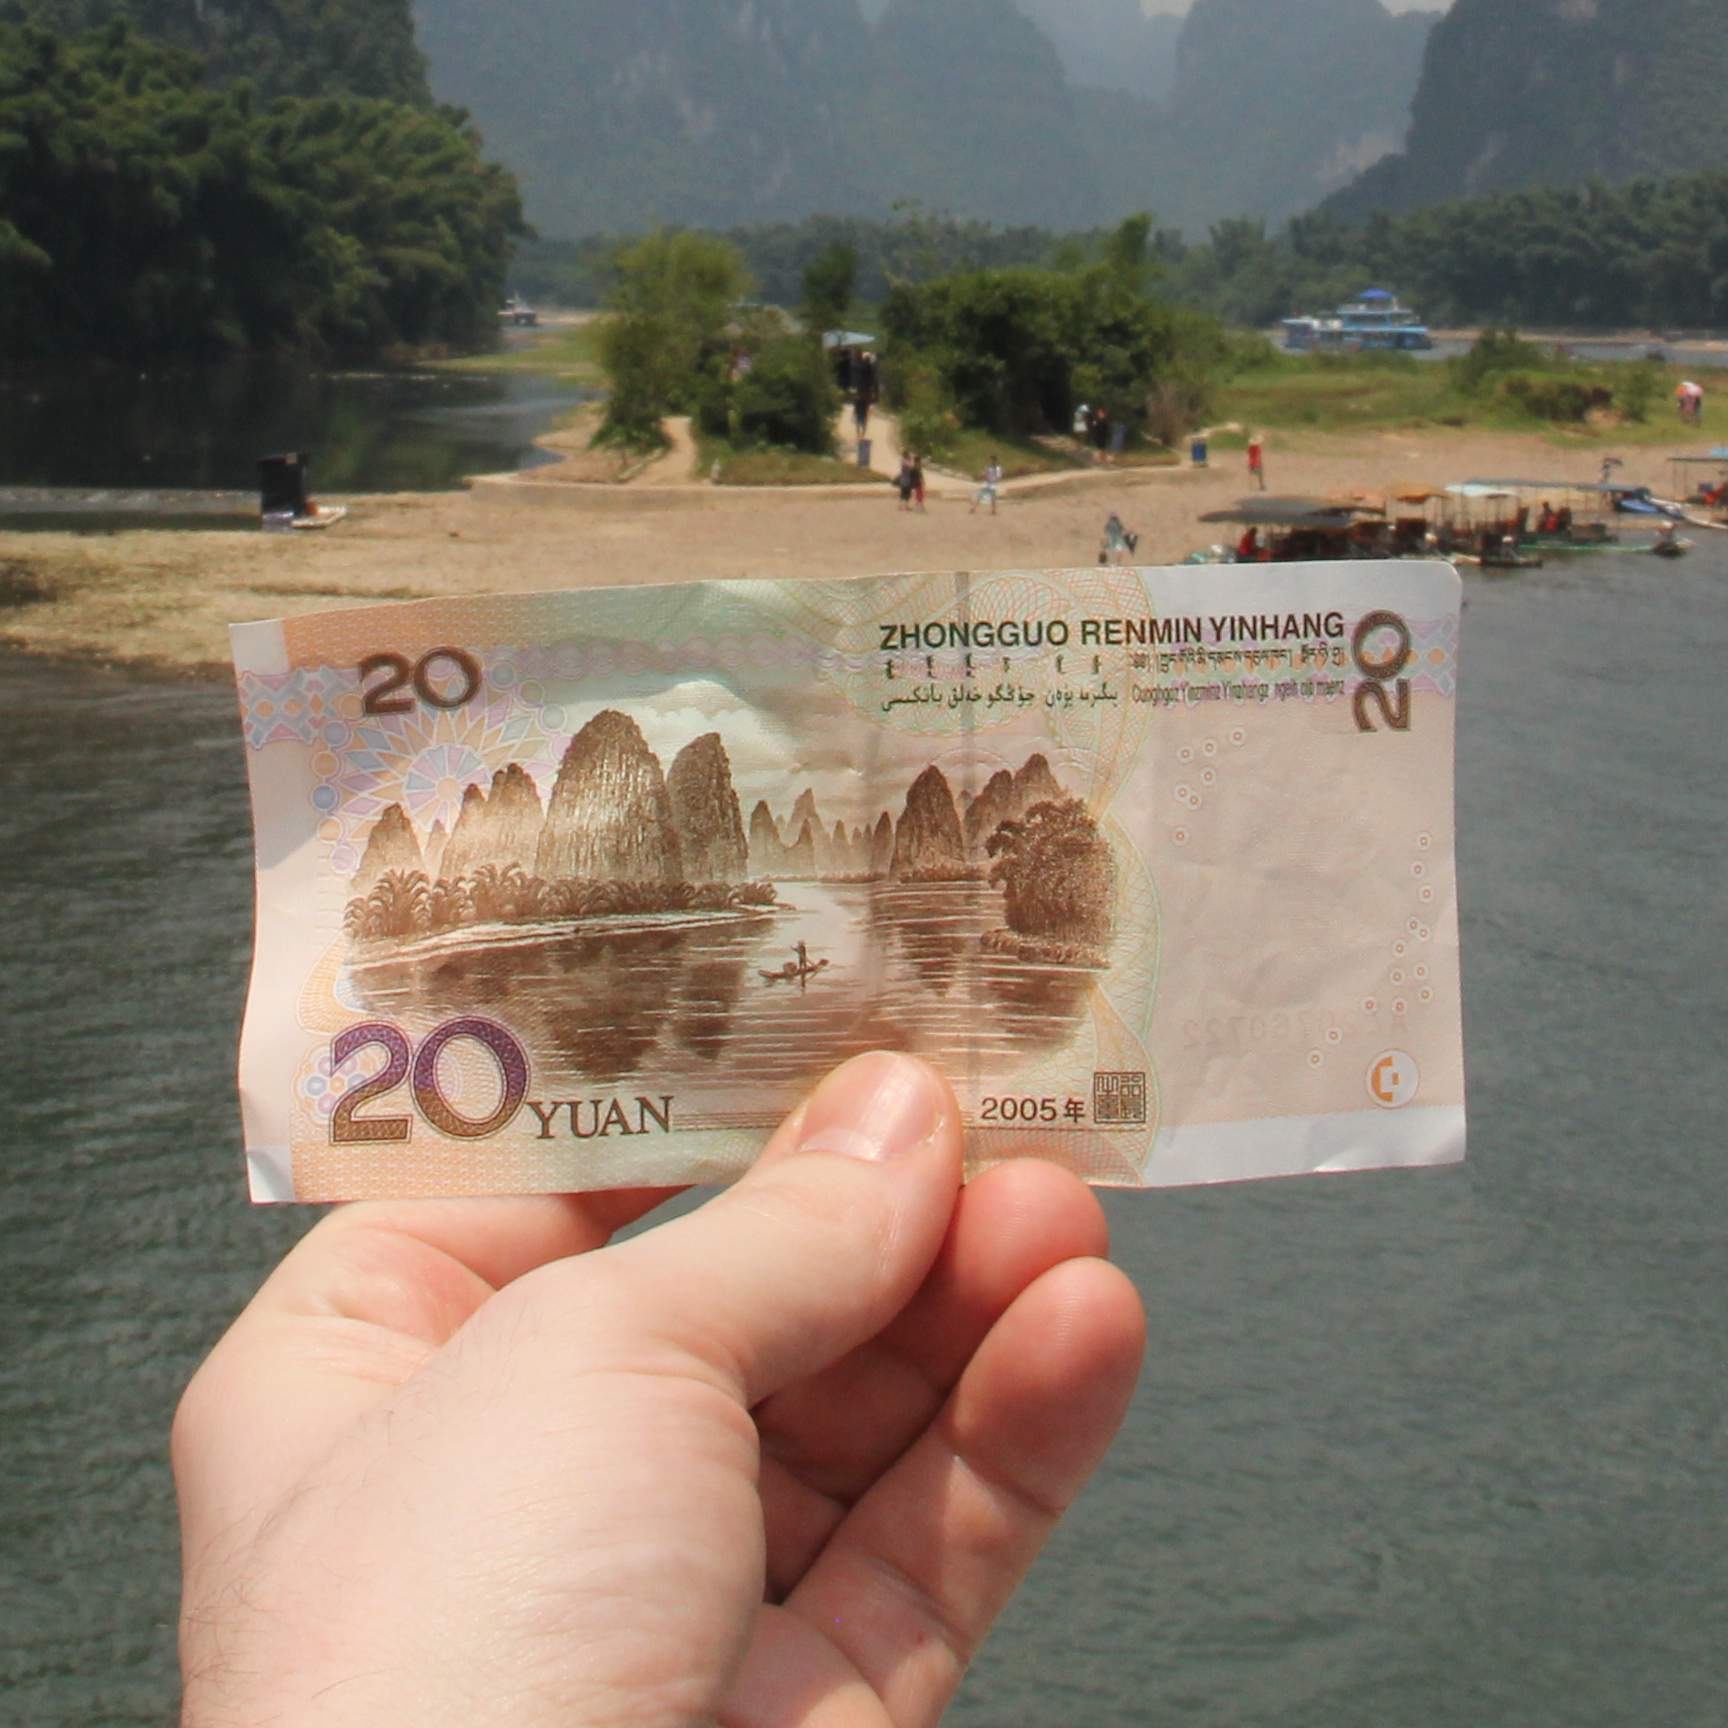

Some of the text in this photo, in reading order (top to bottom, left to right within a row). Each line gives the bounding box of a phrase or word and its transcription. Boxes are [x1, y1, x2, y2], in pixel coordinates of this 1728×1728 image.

[879, 611, 1345, 651] ZHONGGUO RENMIN YINHANG
[358, 646, 482, 715] 20
[1352, 608, 1411, 733] 20
[329, 1015, 675, 1146] 20 YUAN
[980, 1096, 1086, 1124] 2005年
